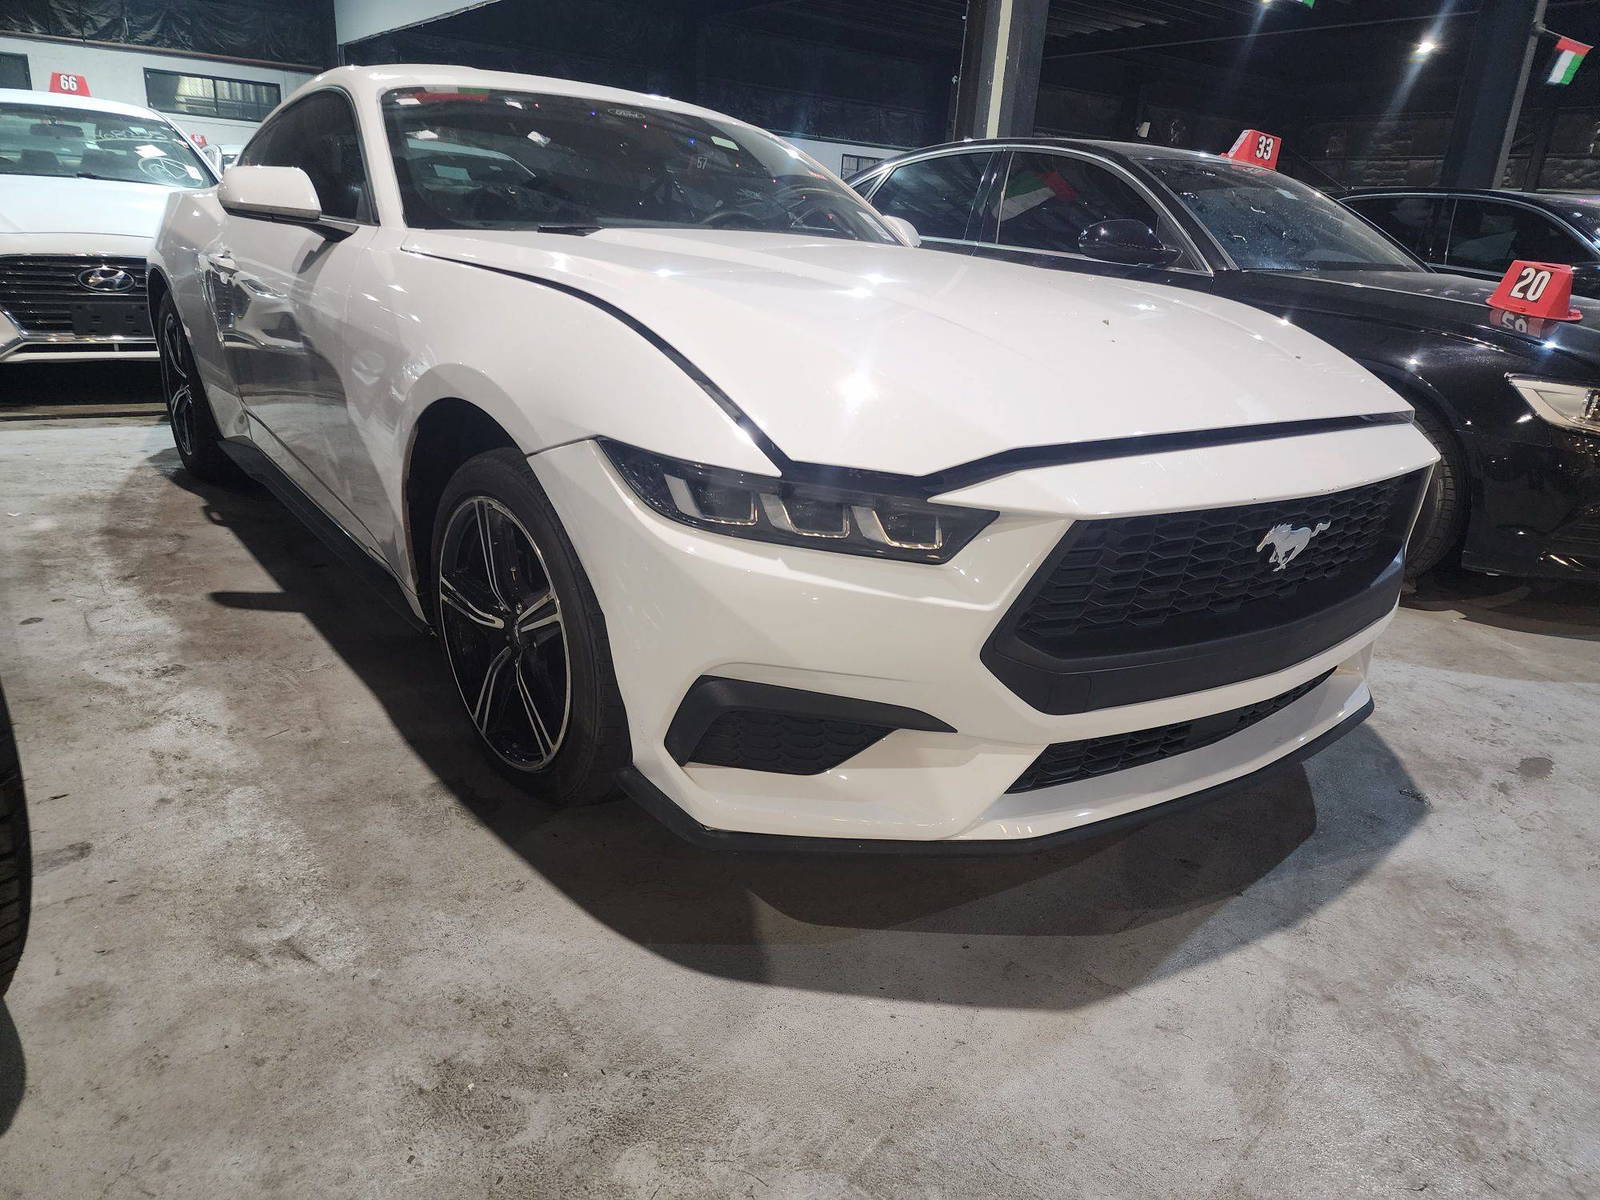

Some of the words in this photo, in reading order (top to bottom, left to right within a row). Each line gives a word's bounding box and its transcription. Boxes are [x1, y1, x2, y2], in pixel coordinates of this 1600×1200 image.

[60, 74, 78, 91] 66
[1255, 135, 1274, 160] 33
[1509, 267, 1552, 302] 20
